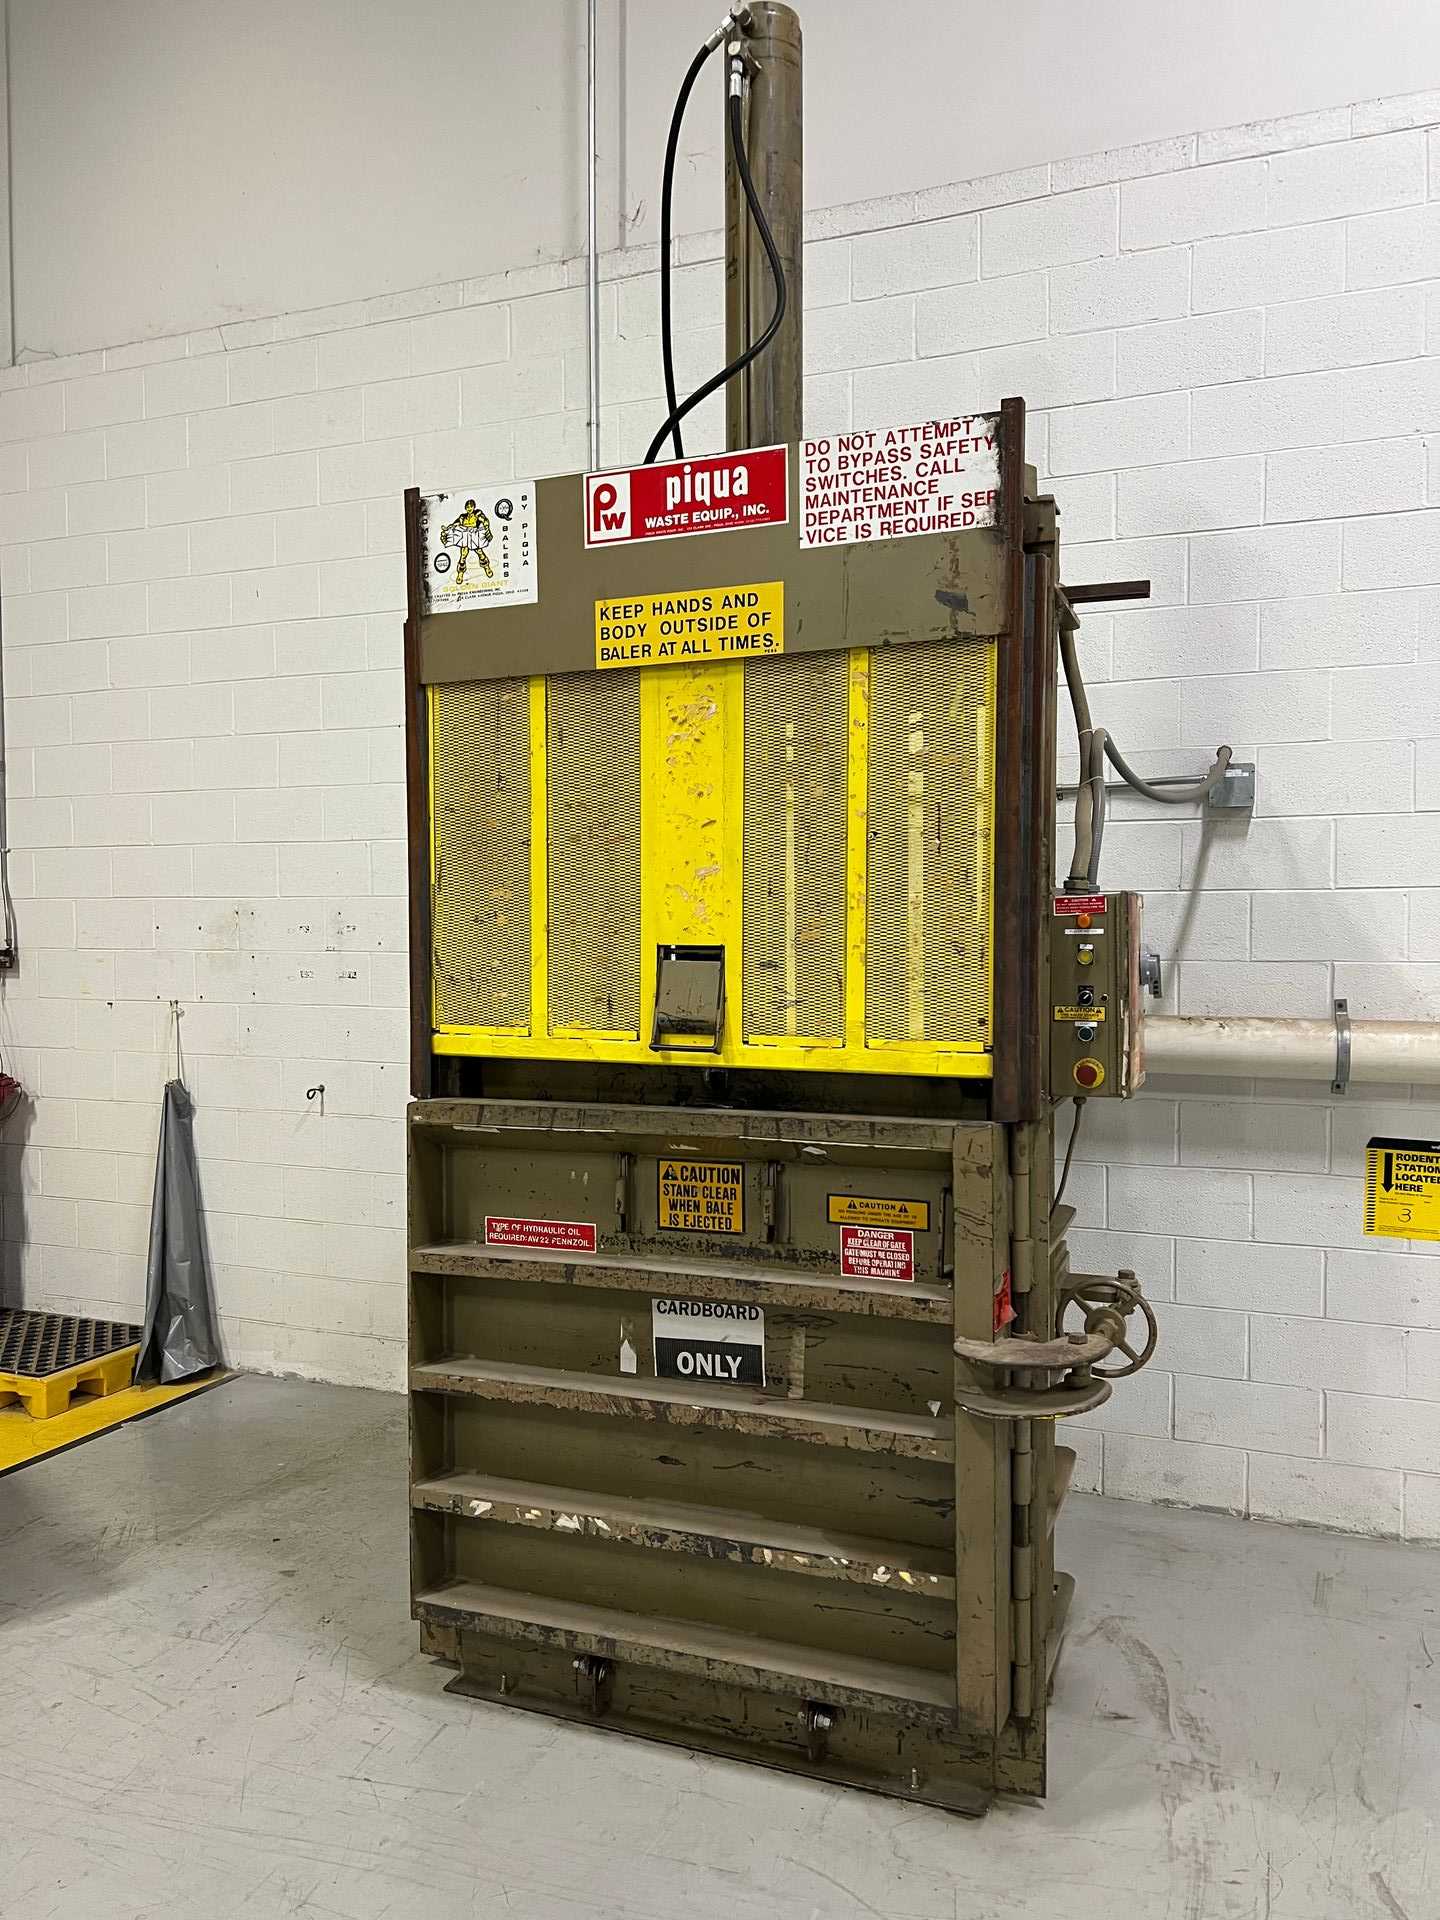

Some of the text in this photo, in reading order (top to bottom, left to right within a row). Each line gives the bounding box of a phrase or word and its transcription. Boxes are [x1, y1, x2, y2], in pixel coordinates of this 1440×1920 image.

[805, 420, 974, 457] DO NOT ATTEMPT
[806, 436, 994, 474] TO BYPASS SAFETY
[806, 458, 965, 492] SWITCHES. CALL
[666, 464, 749, 511] piqua
[806, 479, 939, 509] MAINTENANCE
[645, 513, 688, 528] WASTE
[692, 508, 739, 523] EQUIP.,
[743, 503, 770, 516] INC.
[806, 498, 930, 527] DEPARTMENT
[937, 496, 953, 511] IF
[806, 511, 979, 544] VICE IS REQUIRED.
[600, 592, 759, 621] KEEP HANDS AND
[600, 612, 771, 640] BODY OUTSIDE OF
[601, 633, 780, 661] BALER AT ALL TIMES.
[1396, 1153, 1440, 1164] RODENT
[680, 1165, 740, 1185] CAUTION
[663, 1183, 737, 1200] STAND CLEAR
[1395, 1183, 1423, 1192] HERE
[669, 1199, 734, 1215] WHEN BALE
[859, 1202, 896, 1210] CAUTION
[1398, 1208, 1411, 1223] 3
[492, 1222, 509, 1232] TYPE
[523, 1225, 566, 1235] HYDRAULIC
[568, 1228, 581, 1236] OIL
[669, 1213, 732, 1230] IS EJECTED
[848, 1238, 906, 1250] KEEP CLEAR OF GATE
[857, 1230, 894, 1240] DANGER
[844, 1248, 910, 1261] GATE MUST BE CLOSED
[848, 1257, 906, 1269] BEFORE OPERATING
[854, 1266, 900, 1277] THIS MACHINE
[657, 1300, 760, 1320] CARDBOARD
[677, 1351, 743, 1378] ONLY
